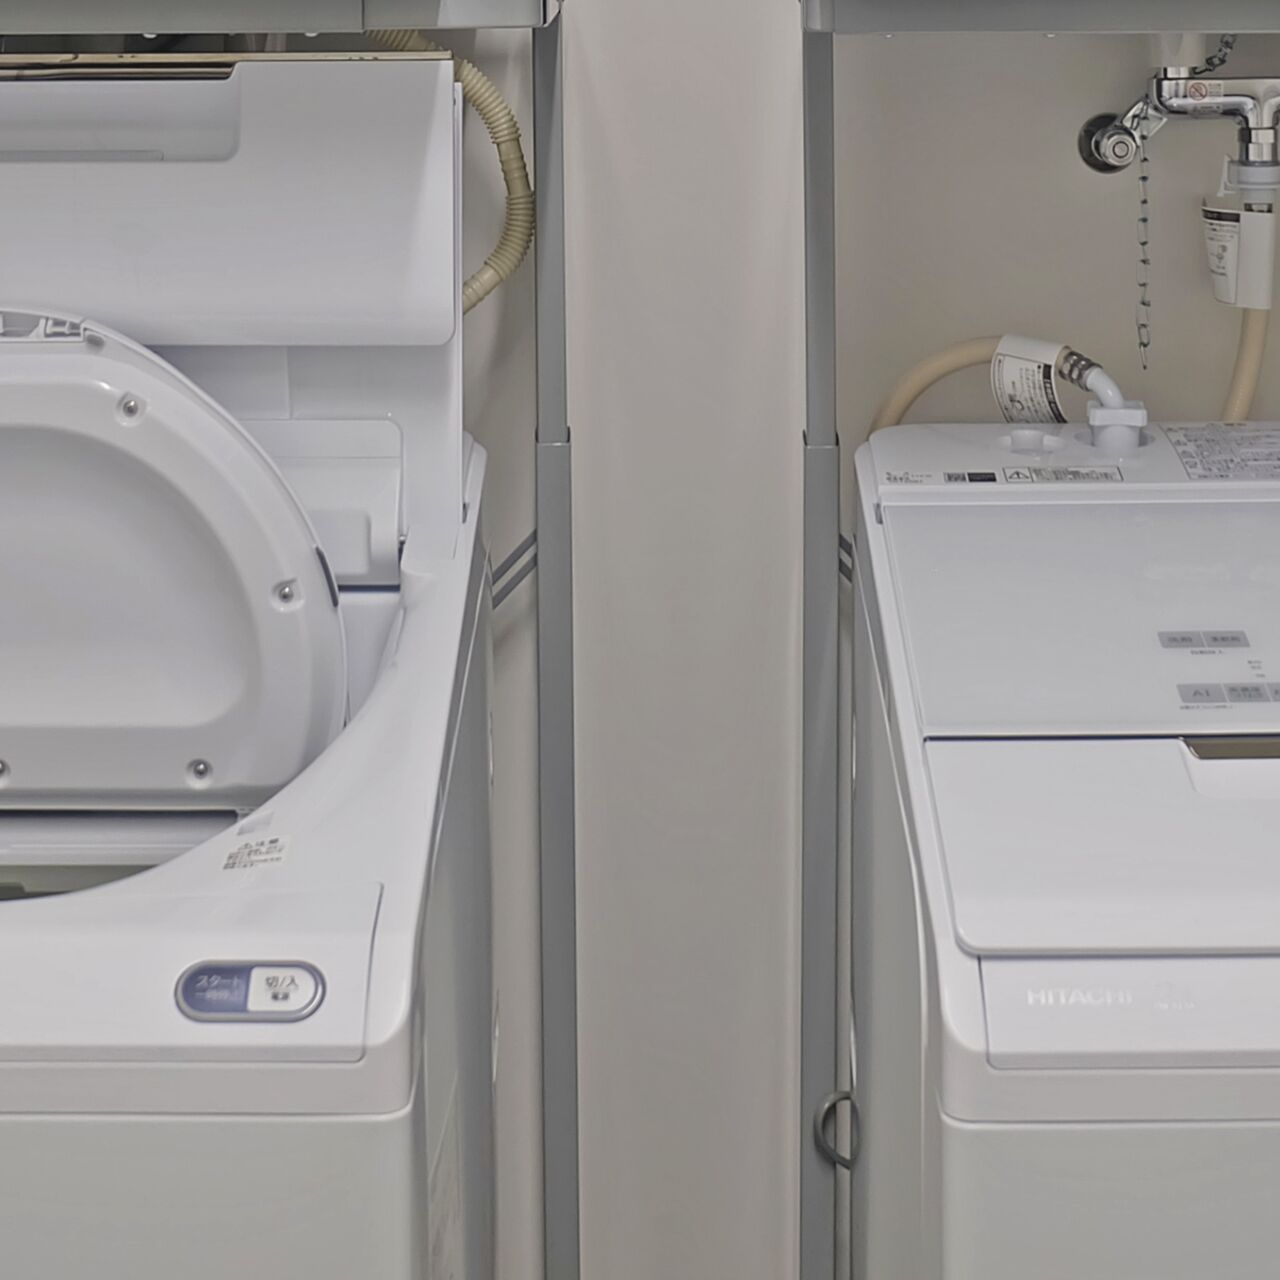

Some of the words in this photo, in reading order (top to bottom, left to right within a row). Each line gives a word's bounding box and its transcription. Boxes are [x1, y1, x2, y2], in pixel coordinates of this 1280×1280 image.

[196, 976, 242, 987] スタート
[1027, 989, 1133, 1005] HITACHI
